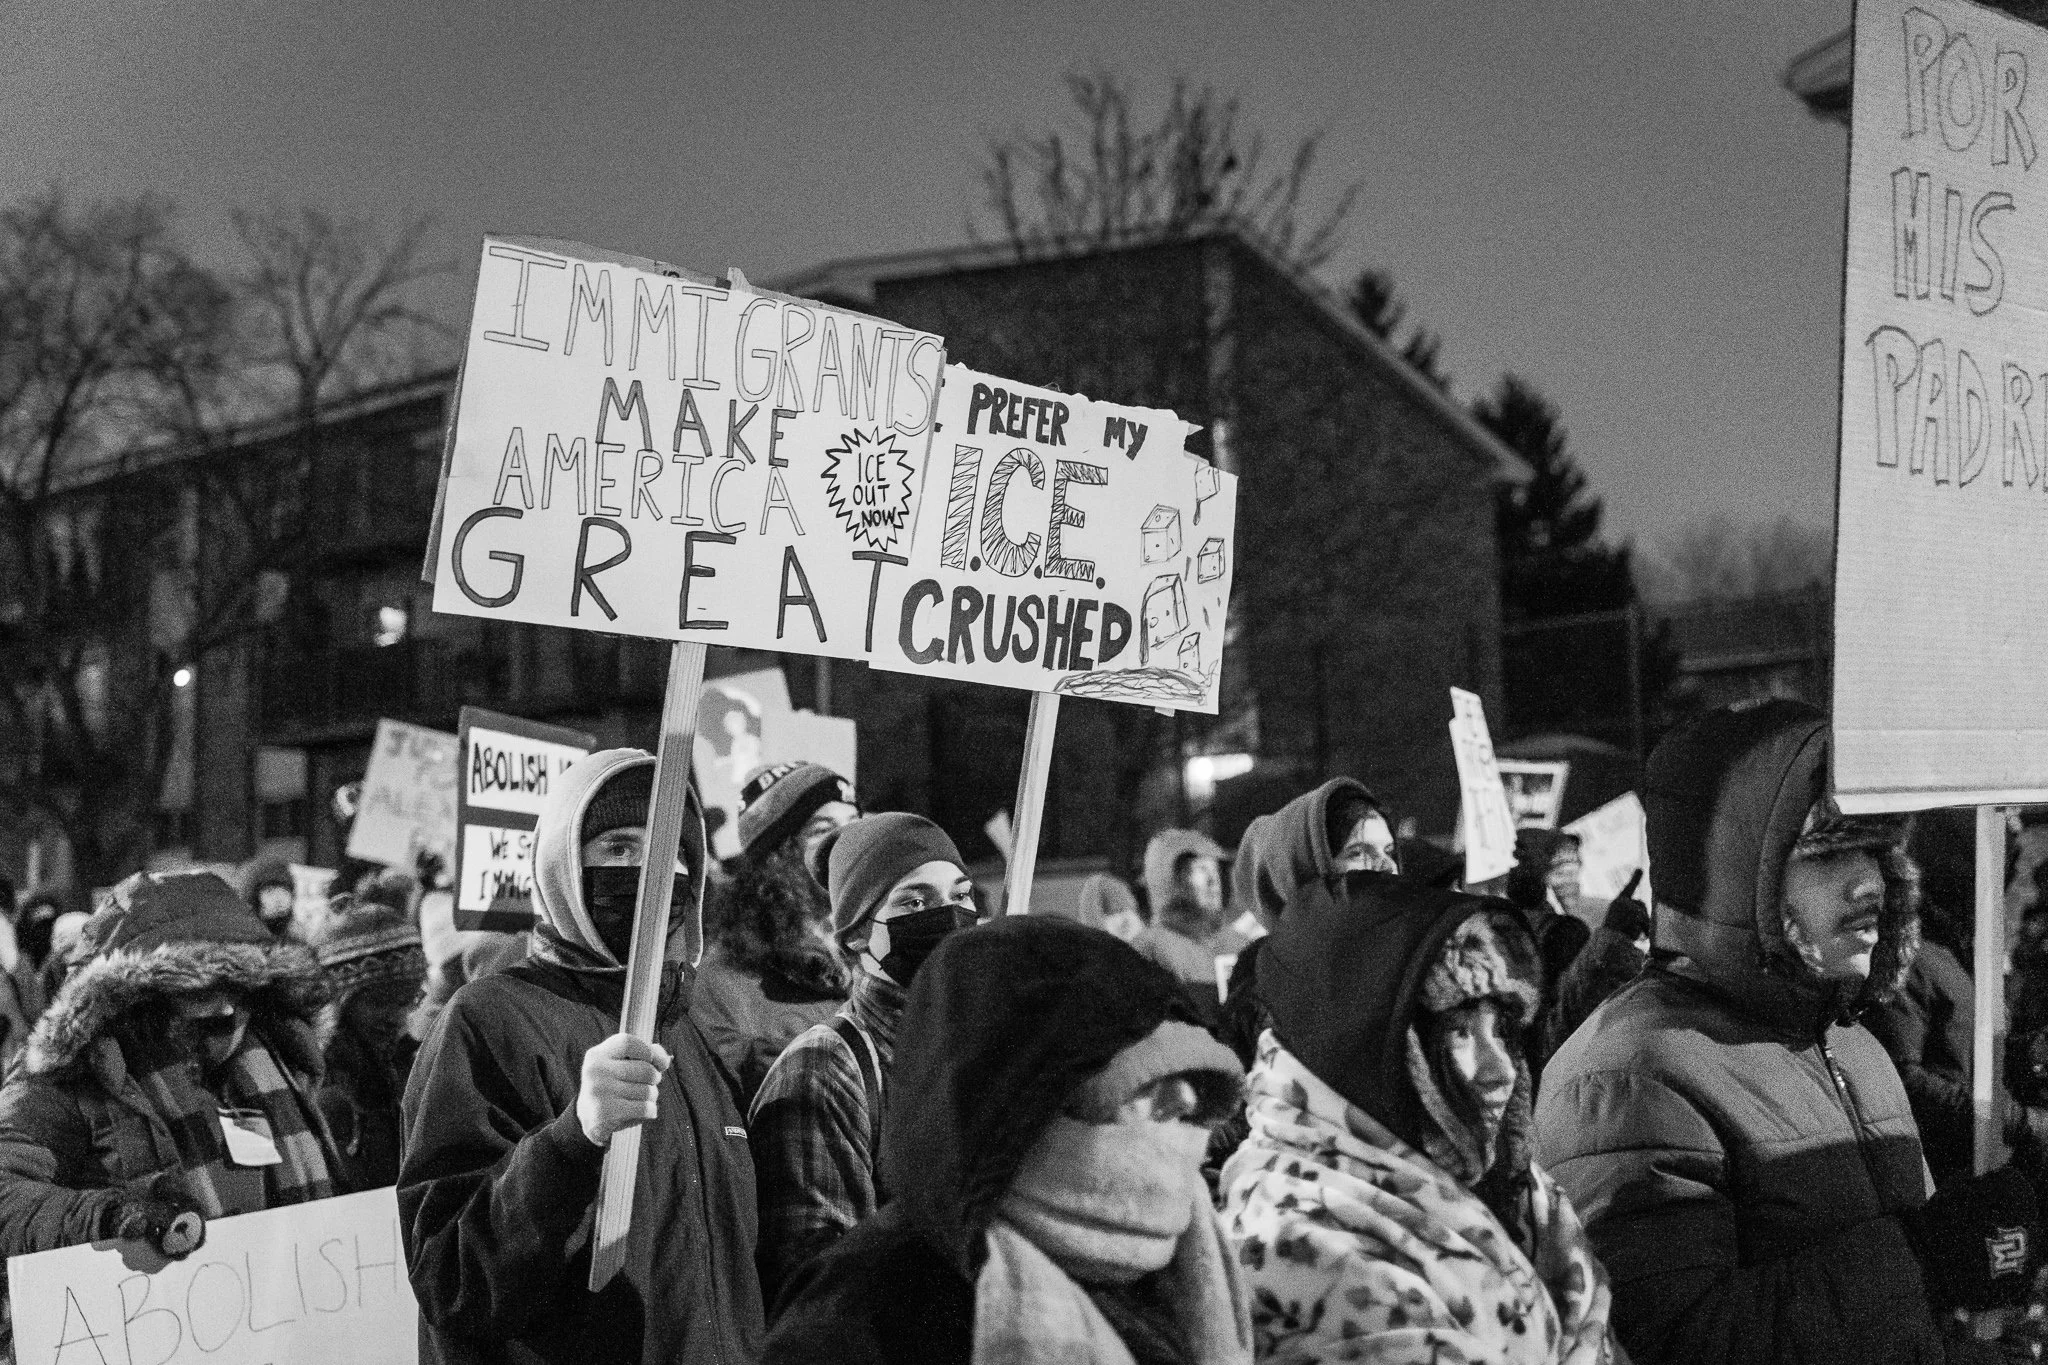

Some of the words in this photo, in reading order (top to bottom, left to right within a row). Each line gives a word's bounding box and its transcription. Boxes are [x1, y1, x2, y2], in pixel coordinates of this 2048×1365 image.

[1901, 6, 2038, 171] POR
[1891, 166, 2016, 317] HIS
[484, 246, 944, 437] IMMIGRANTS
[595, 377, 797, 468] MAKE
[966, 382, 1070, 447] PREFER
[493, 427, 805, 535] AMERICA
[852, 484, 890, 506] OUT
[858, 452, 887, 484] ICE
[860, 506, 897, 528] NOW
[941, 444, 1108, 589] I.C.E.
[452, 507, 908, 652] GREAT
[898, 579, 1132, 671] CRUSHED
[471, 742, 548, 795] ABOLISH
[54, 1218, 399, 1365] ABOLISH
